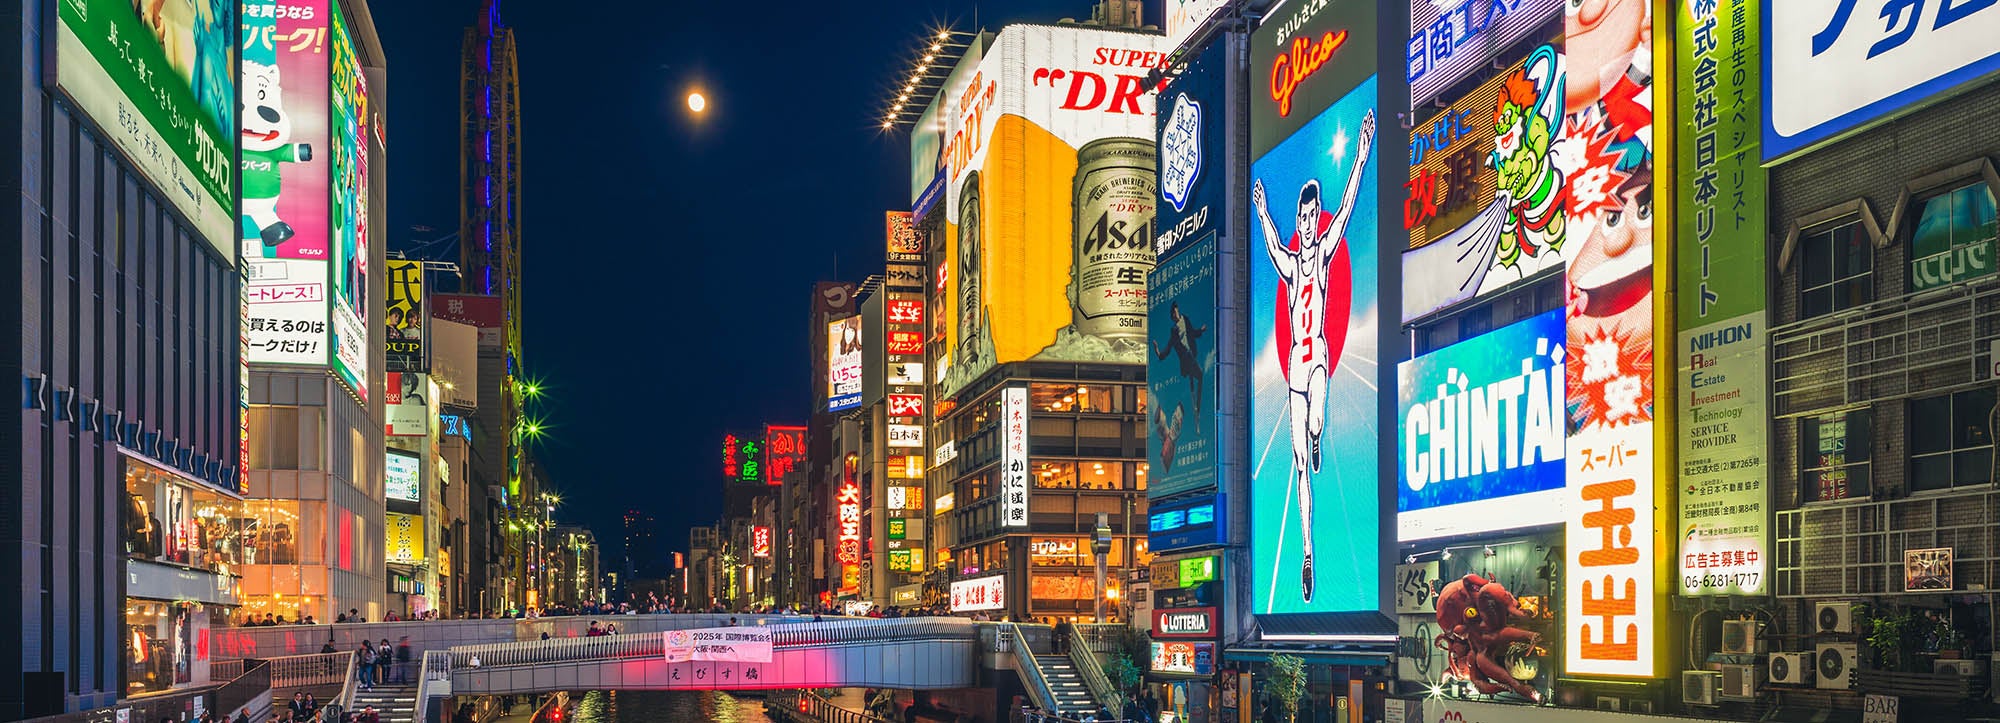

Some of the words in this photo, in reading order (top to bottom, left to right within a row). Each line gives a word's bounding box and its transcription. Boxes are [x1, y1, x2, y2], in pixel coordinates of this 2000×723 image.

[242, 24, 327, 53] パーク!
[1271, 29, 1349, 117] Glico
[1409, 106, 1473, 166] かぜに
[195, 118, 232, 200] サロンパス
[1157, 205, 1208, 257] 雪印メグミルク
[1117, 266, 1144, 285] 生
[1119, 318, 1143, 328] 350ml
[1301, 277, 1314, 363] グリコ
[1691, 323, 1751, 352] NIHON
[1691, 353, 1717, 370] Real
[832, 365, 862, 382] いちこ
[1691, 372, 1725, 389] Estate
[1691, 388, 1741, 407] Investment
[1690, 406, 1743, 423] Technology
[890, 428, 920, 441] 白木屋
[1691, 422, 1728, 438] SERVICE
[1691, 433, 1737, 450] PROVIDER
[1581, 440, 1637, 472] スーパー
[1700, 480, 1759, 496] 全日本不動産協会
[1685, 549, 1758, 569] 広告主募集中
[1550, 561, 1559, 596] 2F
[1578, 478, 1640, 661] 玉出
[1685, 572, 1759, 588] 06-6281-1717
[1169, 614, 1206, 630] LOTTERIA
[692, 632, 722, 641] 2025年
[671, 667, 758, 681] えびす橋
[1865, 697, 1897, 715] BAR
